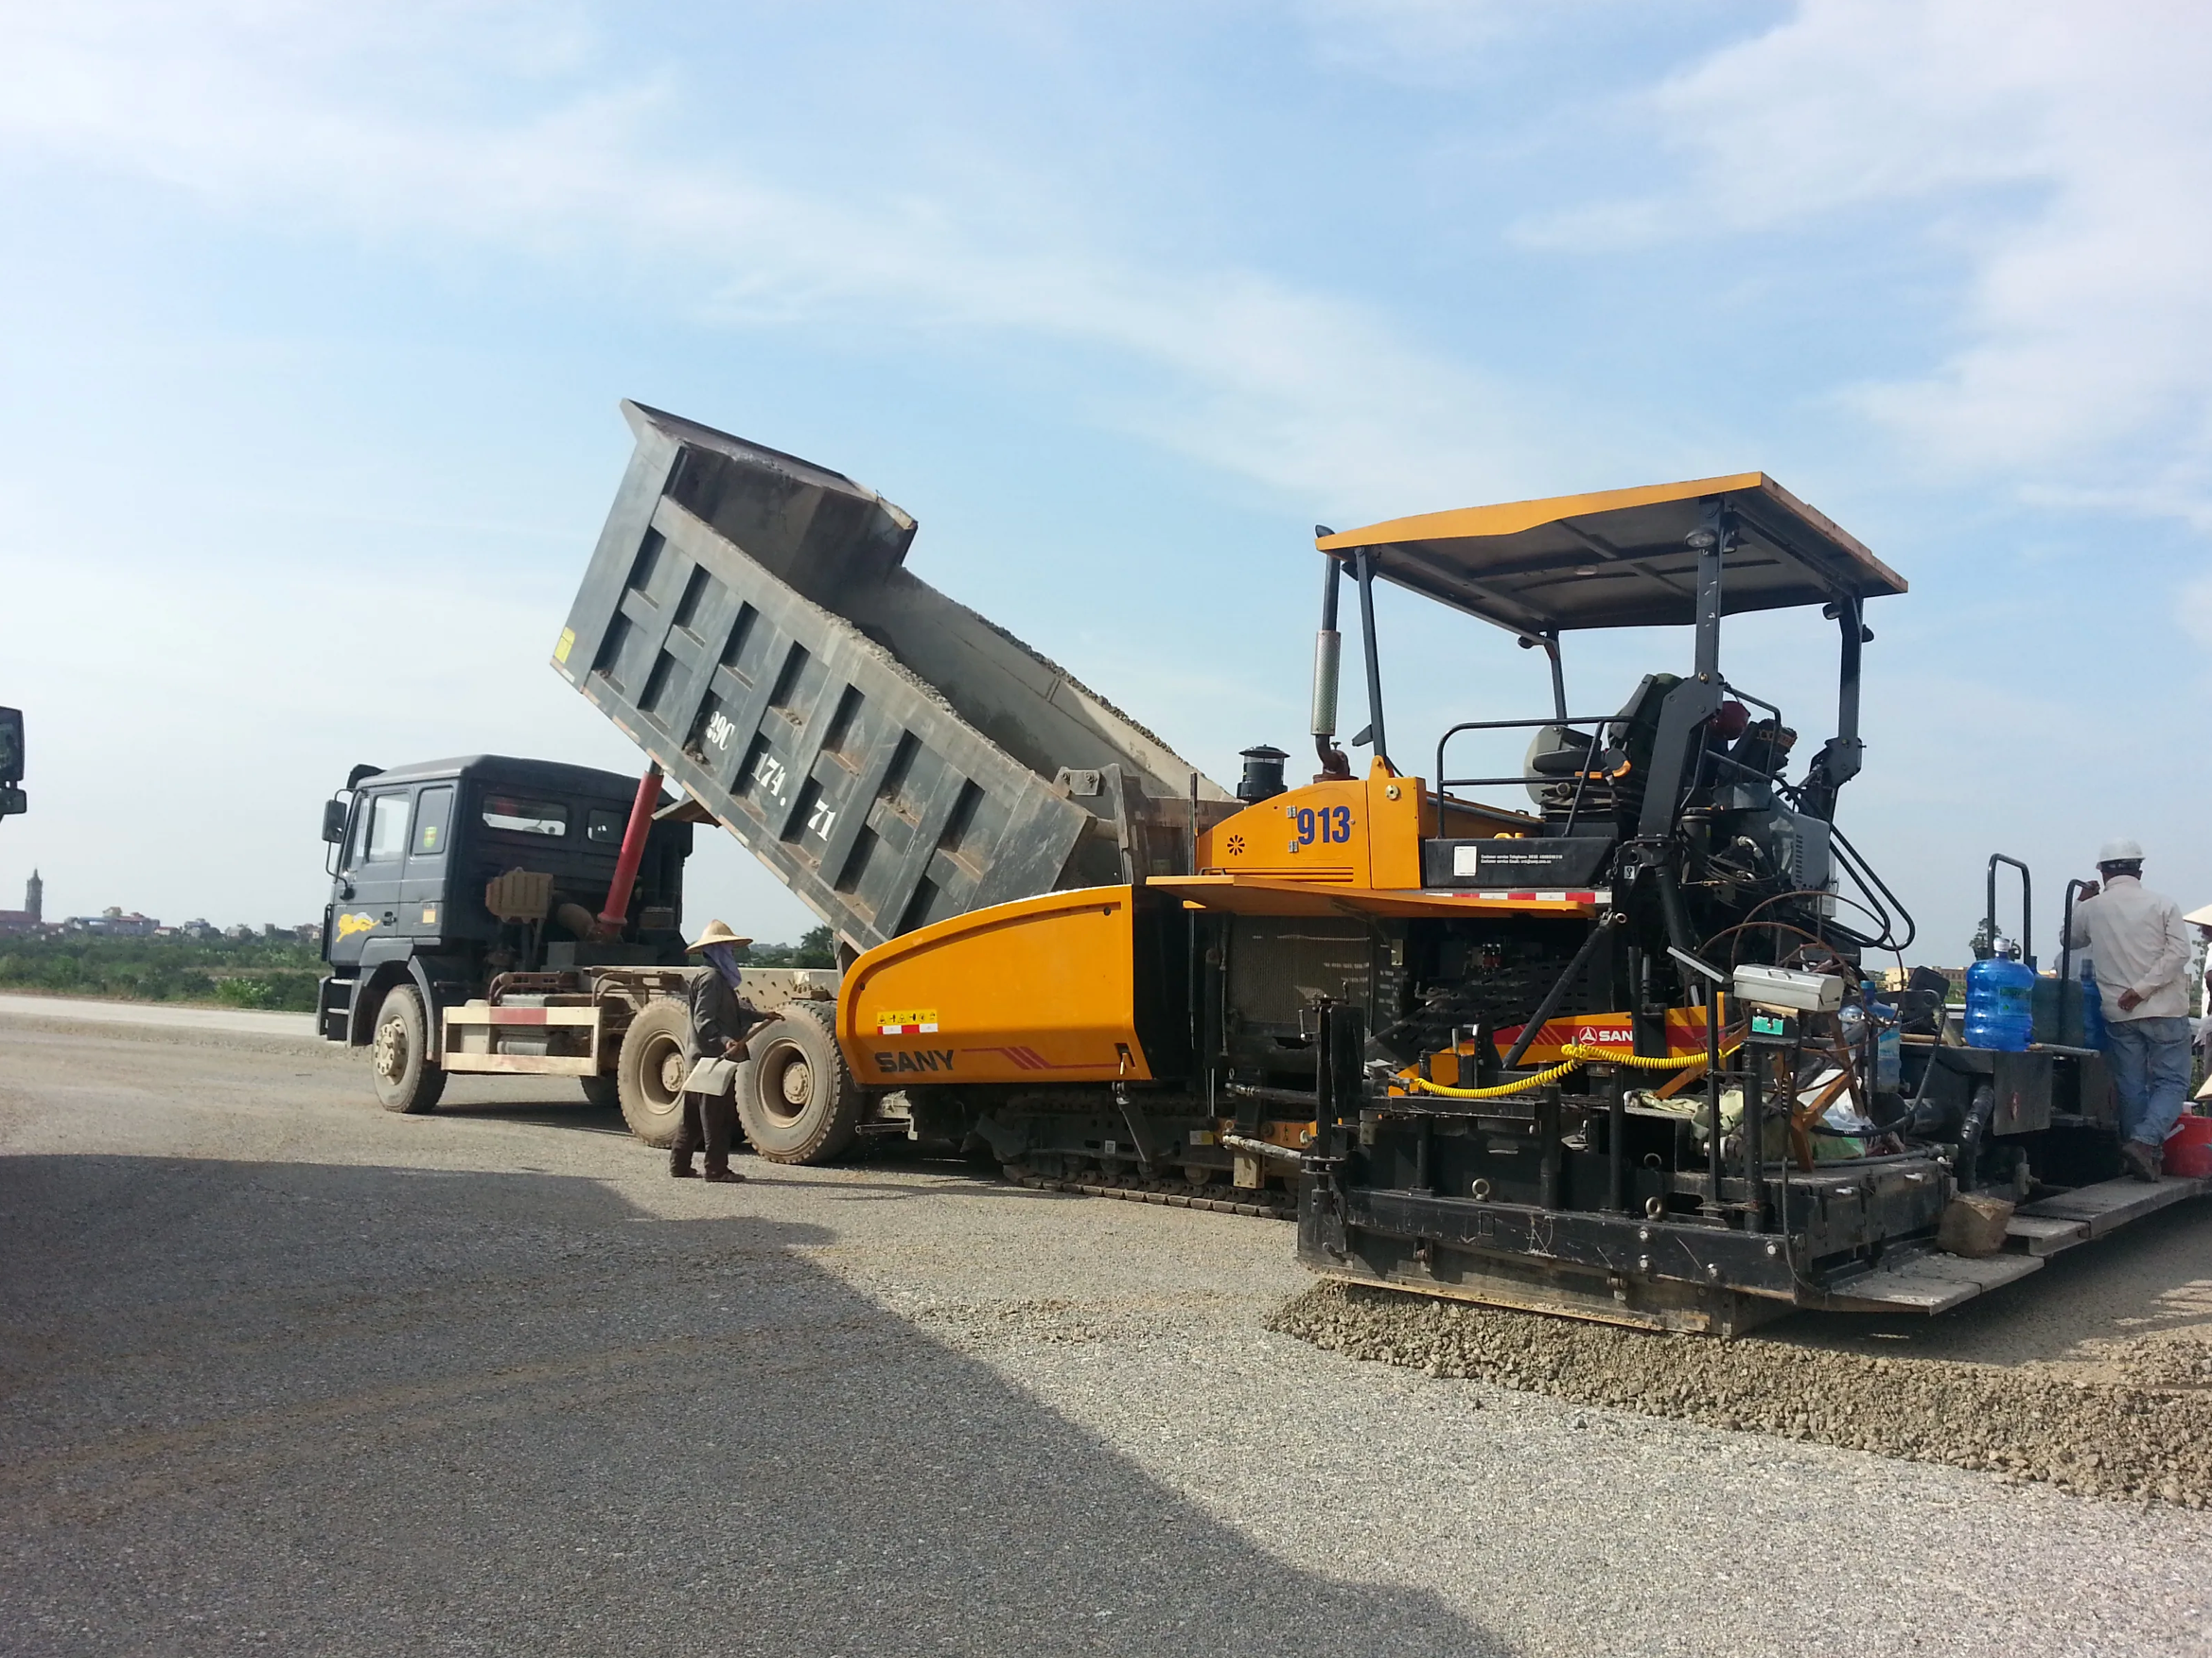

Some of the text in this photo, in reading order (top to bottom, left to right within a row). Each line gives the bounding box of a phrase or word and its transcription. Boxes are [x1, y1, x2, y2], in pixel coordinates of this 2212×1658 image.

[807, 798, 836, 841] 71
[1297, 805, 1350, 845] 913
[1599, 1030, 1633, 1042] SAN
[874, 1049, 954, 1073] SANY
